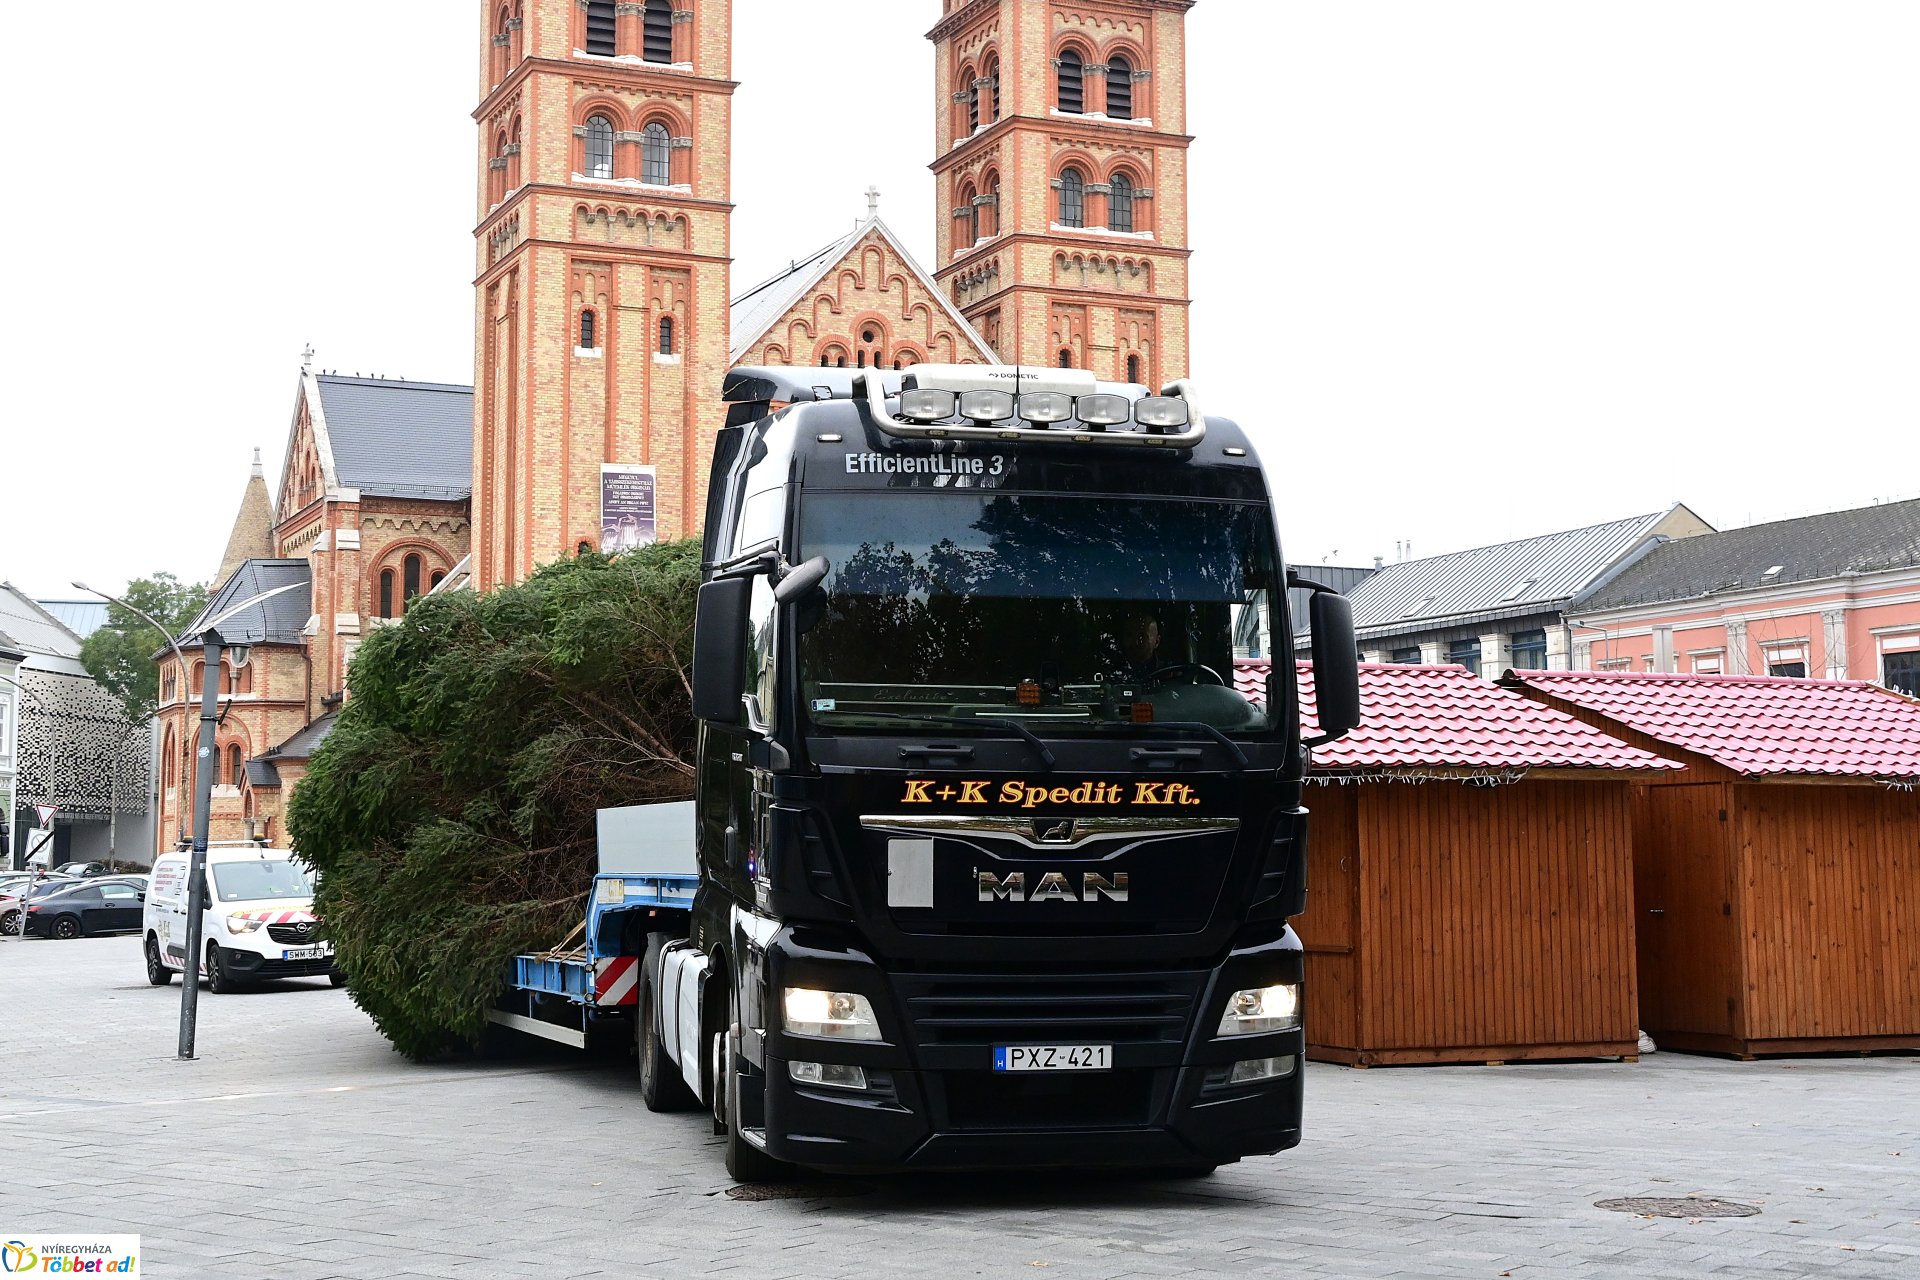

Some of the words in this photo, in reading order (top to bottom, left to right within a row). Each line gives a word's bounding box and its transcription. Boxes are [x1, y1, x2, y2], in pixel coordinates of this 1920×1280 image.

[845, 453, 984, 474] EfficientLine
[988, 455, 1004, 475] 3
[901, 780, 992, 804] K+K
[998, 780, 1124, 809] Spedit
[1131, 782, 1201, 806] Kft.
[978, 872, 1129, 902] MAN
[997, 1060, 1004, 1068] H
[1011, 1047, 1105, 1068] PXZ-421
